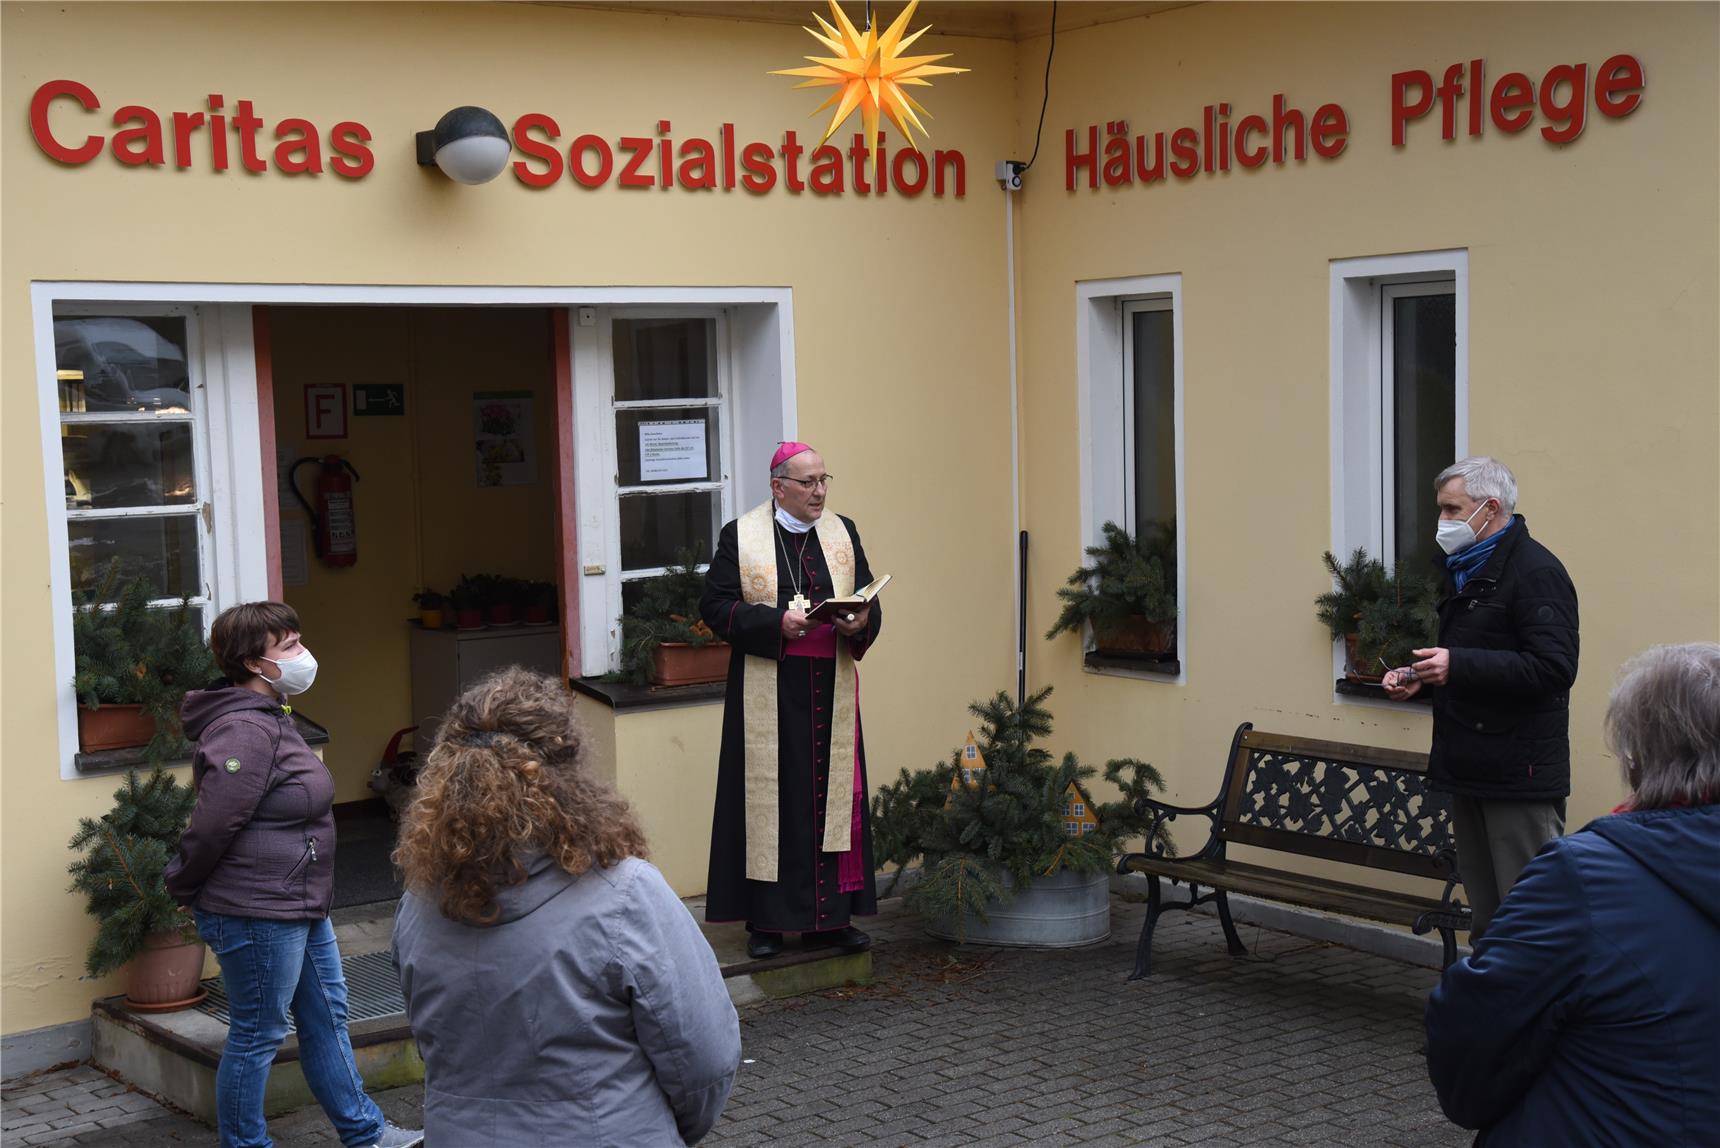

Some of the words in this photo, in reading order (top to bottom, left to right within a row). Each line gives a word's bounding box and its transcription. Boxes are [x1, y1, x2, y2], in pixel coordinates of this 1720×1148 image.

[30, 79, 375, 178] Caritas
[512, 113, 966, 196] Sozialstation
[1065, 95, 1349, 192] Häusliche
[1391, 54, 1645, 147] Pflege
[315, 394, 336, 429] F
